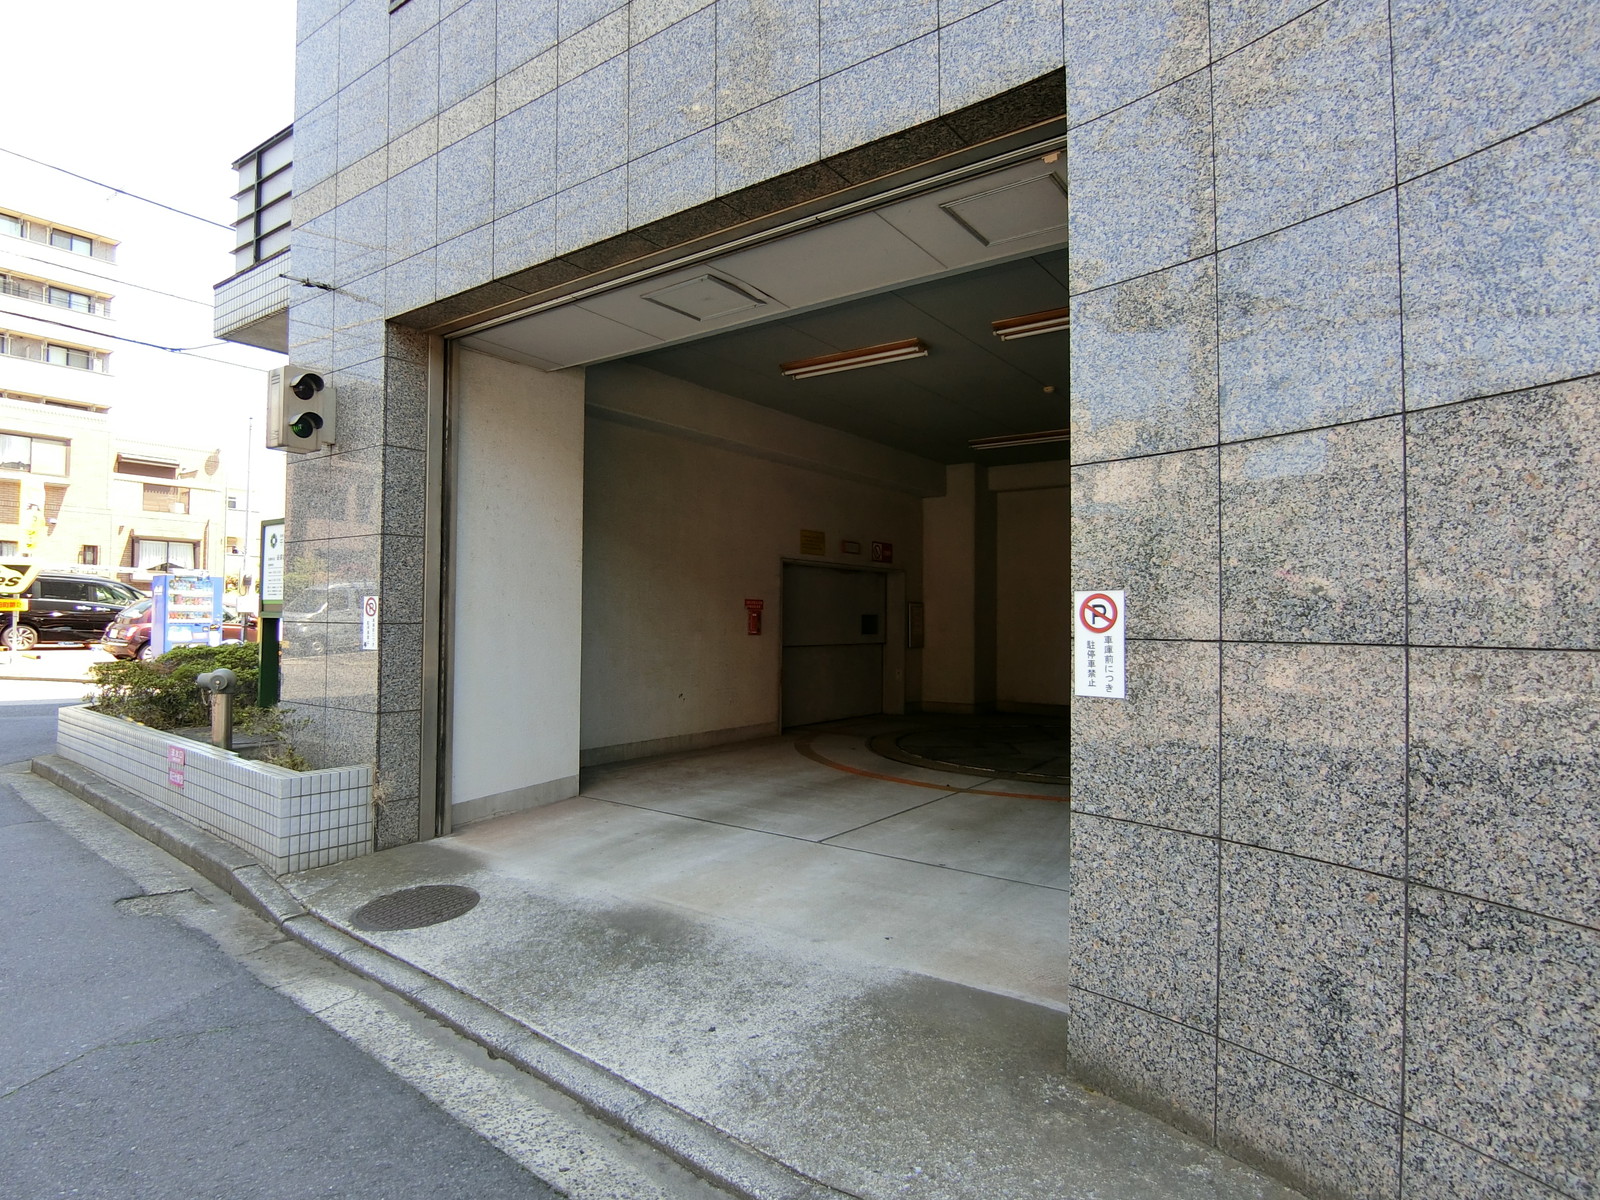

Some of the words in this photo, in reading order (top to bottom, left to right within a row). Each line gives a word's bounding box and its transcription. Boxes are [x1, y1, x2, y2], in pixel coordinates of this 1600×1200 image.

[1086, 640, 1097, 688] 駐停車禁止
[1103, 635, 1114, 693] 車庫前につき
